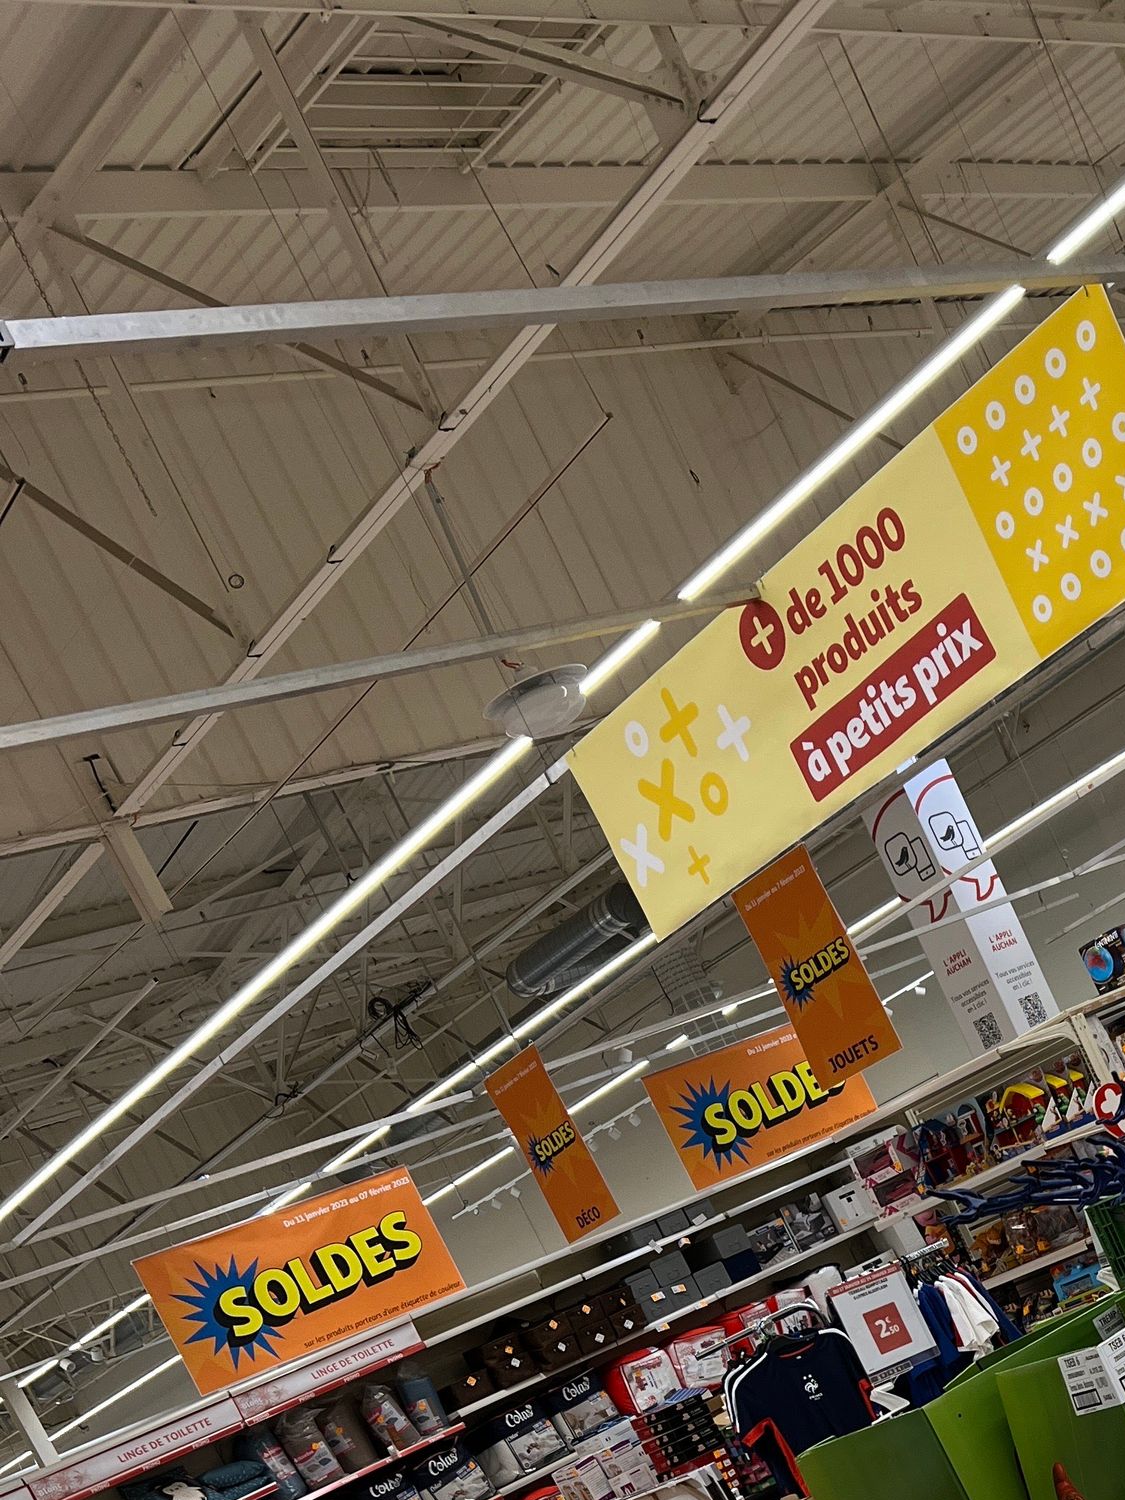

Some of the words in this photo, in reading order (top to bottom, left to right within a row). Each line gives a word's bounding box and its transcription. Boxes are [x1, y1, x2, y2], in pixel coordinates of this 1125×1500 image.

[786, 588, 828, 635] de
[818, 507, 905, 605] 1000
[794, 579, 922, 711] produits
[802, 742, 831, 782] à
[826, 675, 917, 777] petits
[912, 618, 983, 705] prix
[791, 938, 848, 991] SOLDES
[946, 957, 972, 976] AUCHAN
[992, 938, 1017, 952] AUCHAN
[828, 1035, 878, 1073] JOUETS
[704, 1060, 845, 1144] SOLDE
[535, 1121, 574, 1162] SOLDES
[283, 1219, 295, 1228] Du
[295, 1215, 305, 1224] 11
[304, 1207, 330, 1222] janvier
[330, 1199, 348, 1211] 2023
[348, 1197, 359, 1205] au
[358, 1191, 368, 1200] 07
[369, 1182, 392, 1198] février
[392, 1177, 410, 1188] 2023
[577, 1207, 600, 1230] DÉCO
[219, 1211, 422, 1337] SOLDES
[304, 1339, 314, 1348] sur
[315, 1334, 325, 1345] les
[326, 1323, 354, 1340] produits
[354, 1312, 383, 1330] porteurs
[429, 1290, 437, 1298] de
[437, 1281, 460, 1293] couleur
[311, 1363, 339, 1380] LINGE
[340, 1357, 352, 1368] DE
[351, 1339, 394, 1362] TOILETTE
[505, 1405, 533, 1428] Colas
[117, 1445, 148, 1463] LINGE
[149, 1439, 164, 1450] DE
[165, 1418, 212, 1443] TOILETTE
[427, 1448, 458, 1477] Colas
